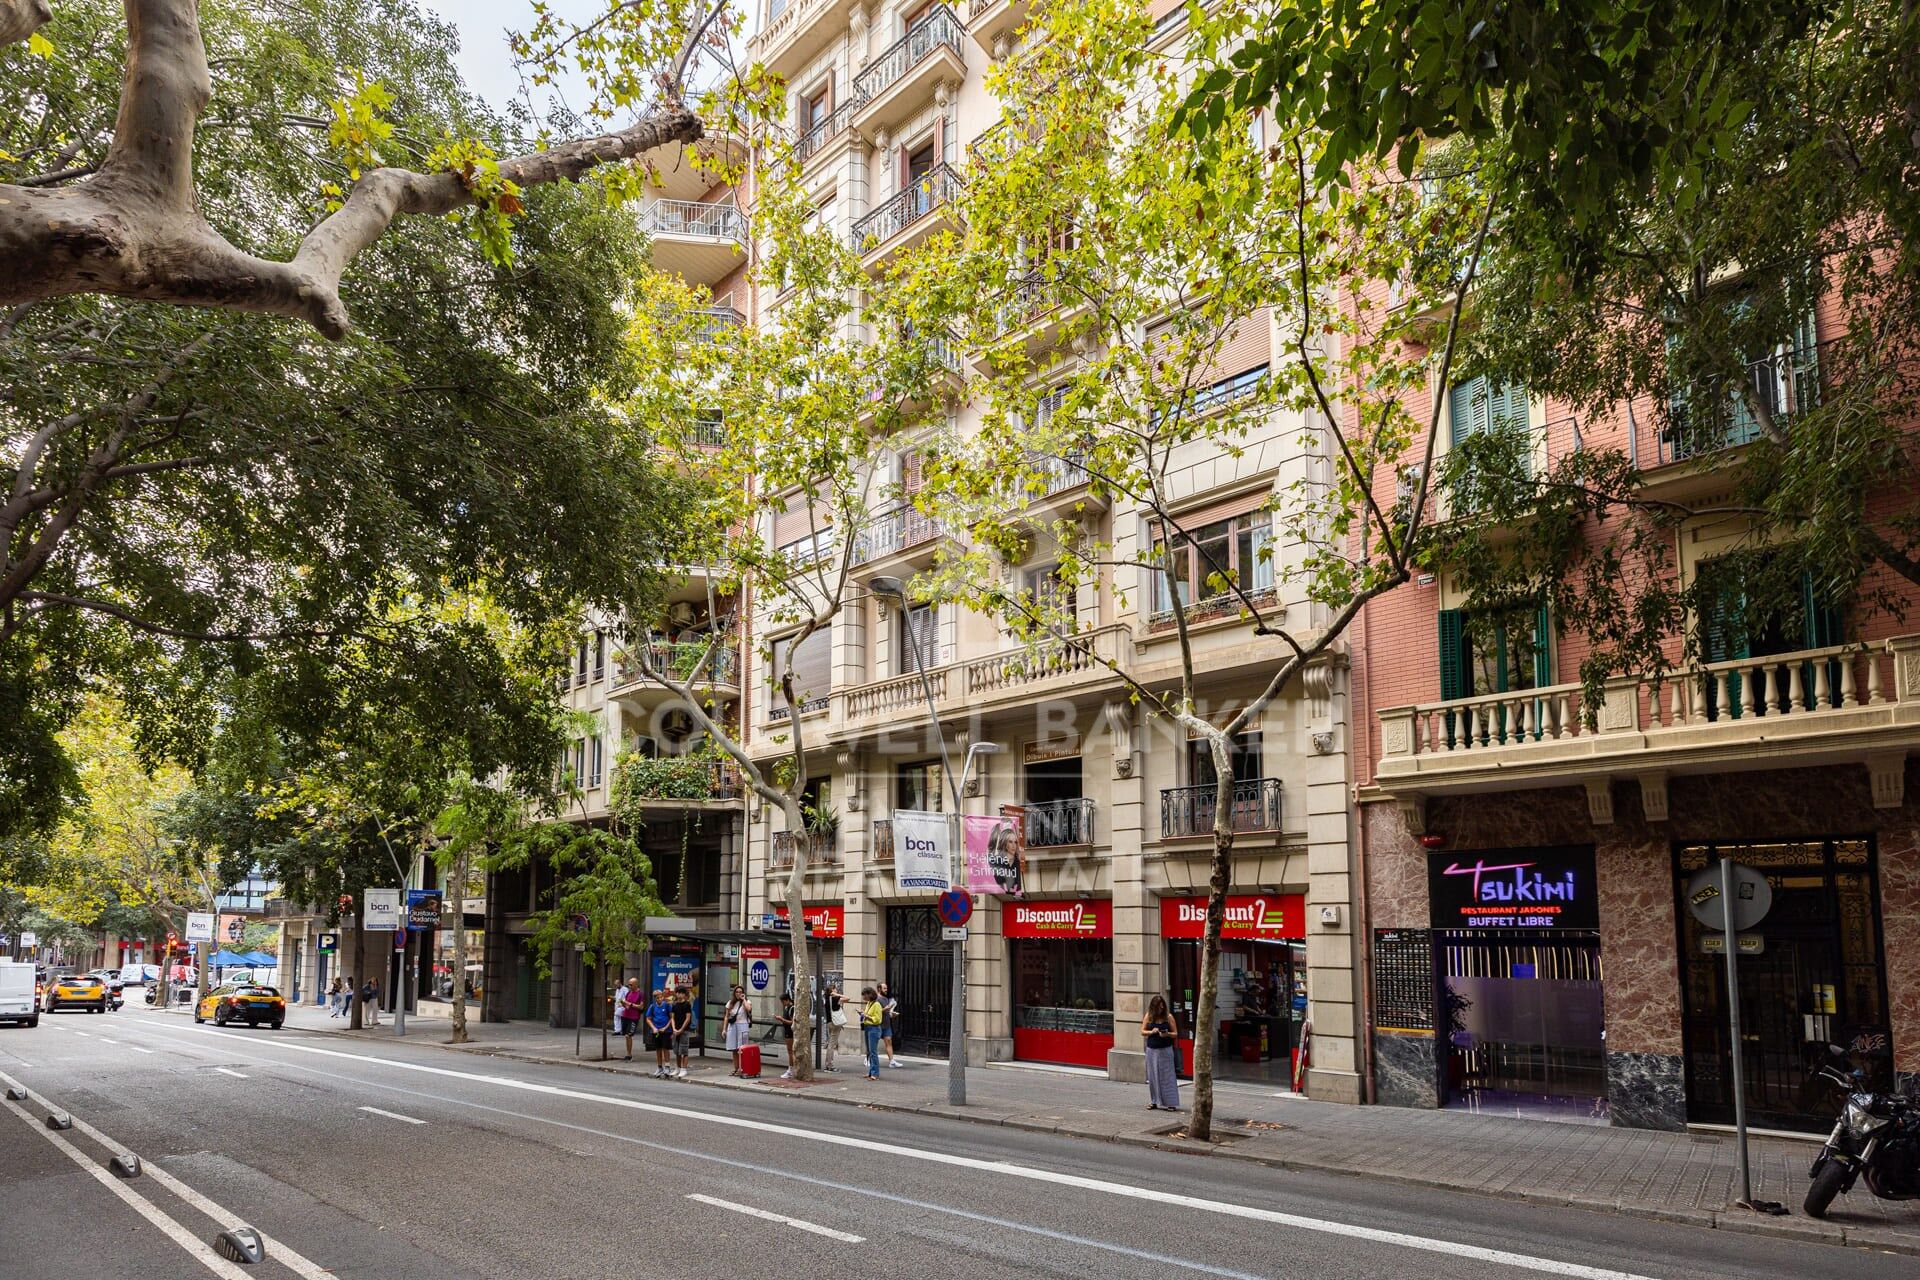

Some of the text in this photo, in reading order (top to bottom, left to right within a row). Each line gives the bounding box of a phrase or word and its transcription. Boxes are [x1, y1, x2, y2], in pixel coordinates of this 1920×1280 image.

[905, 836, 936, 852] bcn
[970, 865, 1017, 878] Grimaud
[371, 902, 390, 911] bcn
[1460, 906, 1562, 915] RESTAURANT JAPONES
[1016, 908, 1075, 923] Discount
[1231, 921, 1254, 930] Carry
[1468, 917, 1554, 927] BUFFET LIBRE
[321, 935, 335, 948] P
[751, 969, 768, 981] H10
